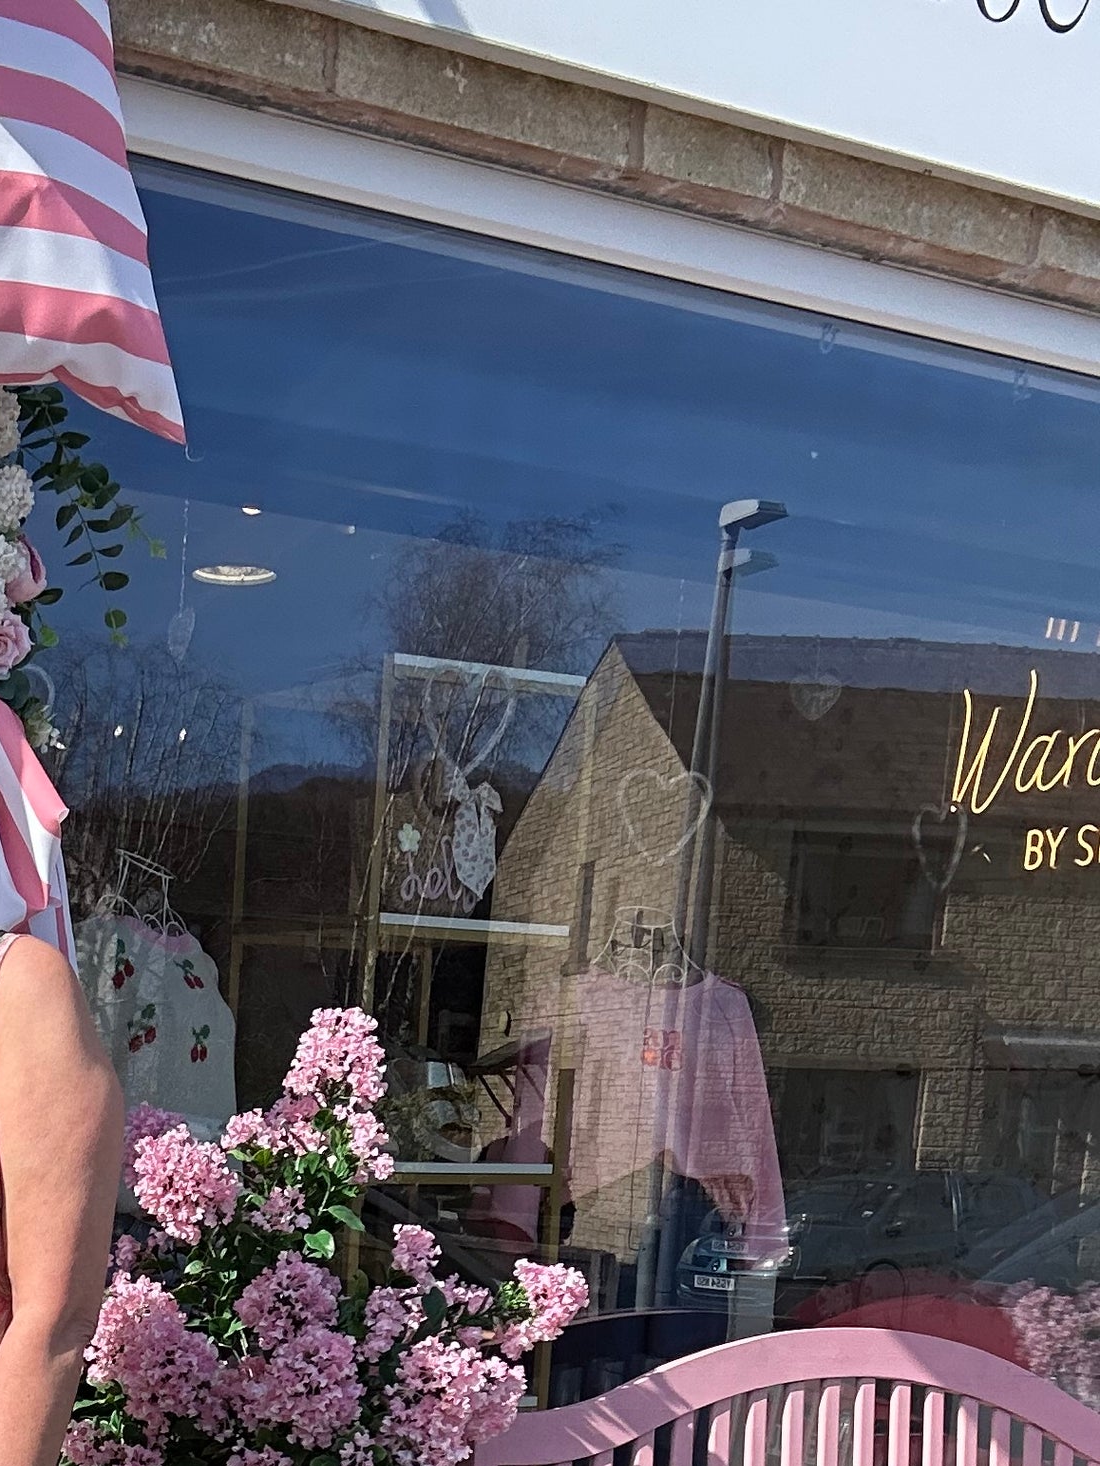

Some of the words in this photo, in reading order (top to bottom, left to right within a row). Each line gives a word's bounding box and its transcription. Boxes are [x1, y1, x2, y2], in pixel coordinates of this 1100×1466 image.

[953, 669, 1100, 814] War
[1024, 828, 1069, 871] BY
[1074, 824, 1100, 867] S
